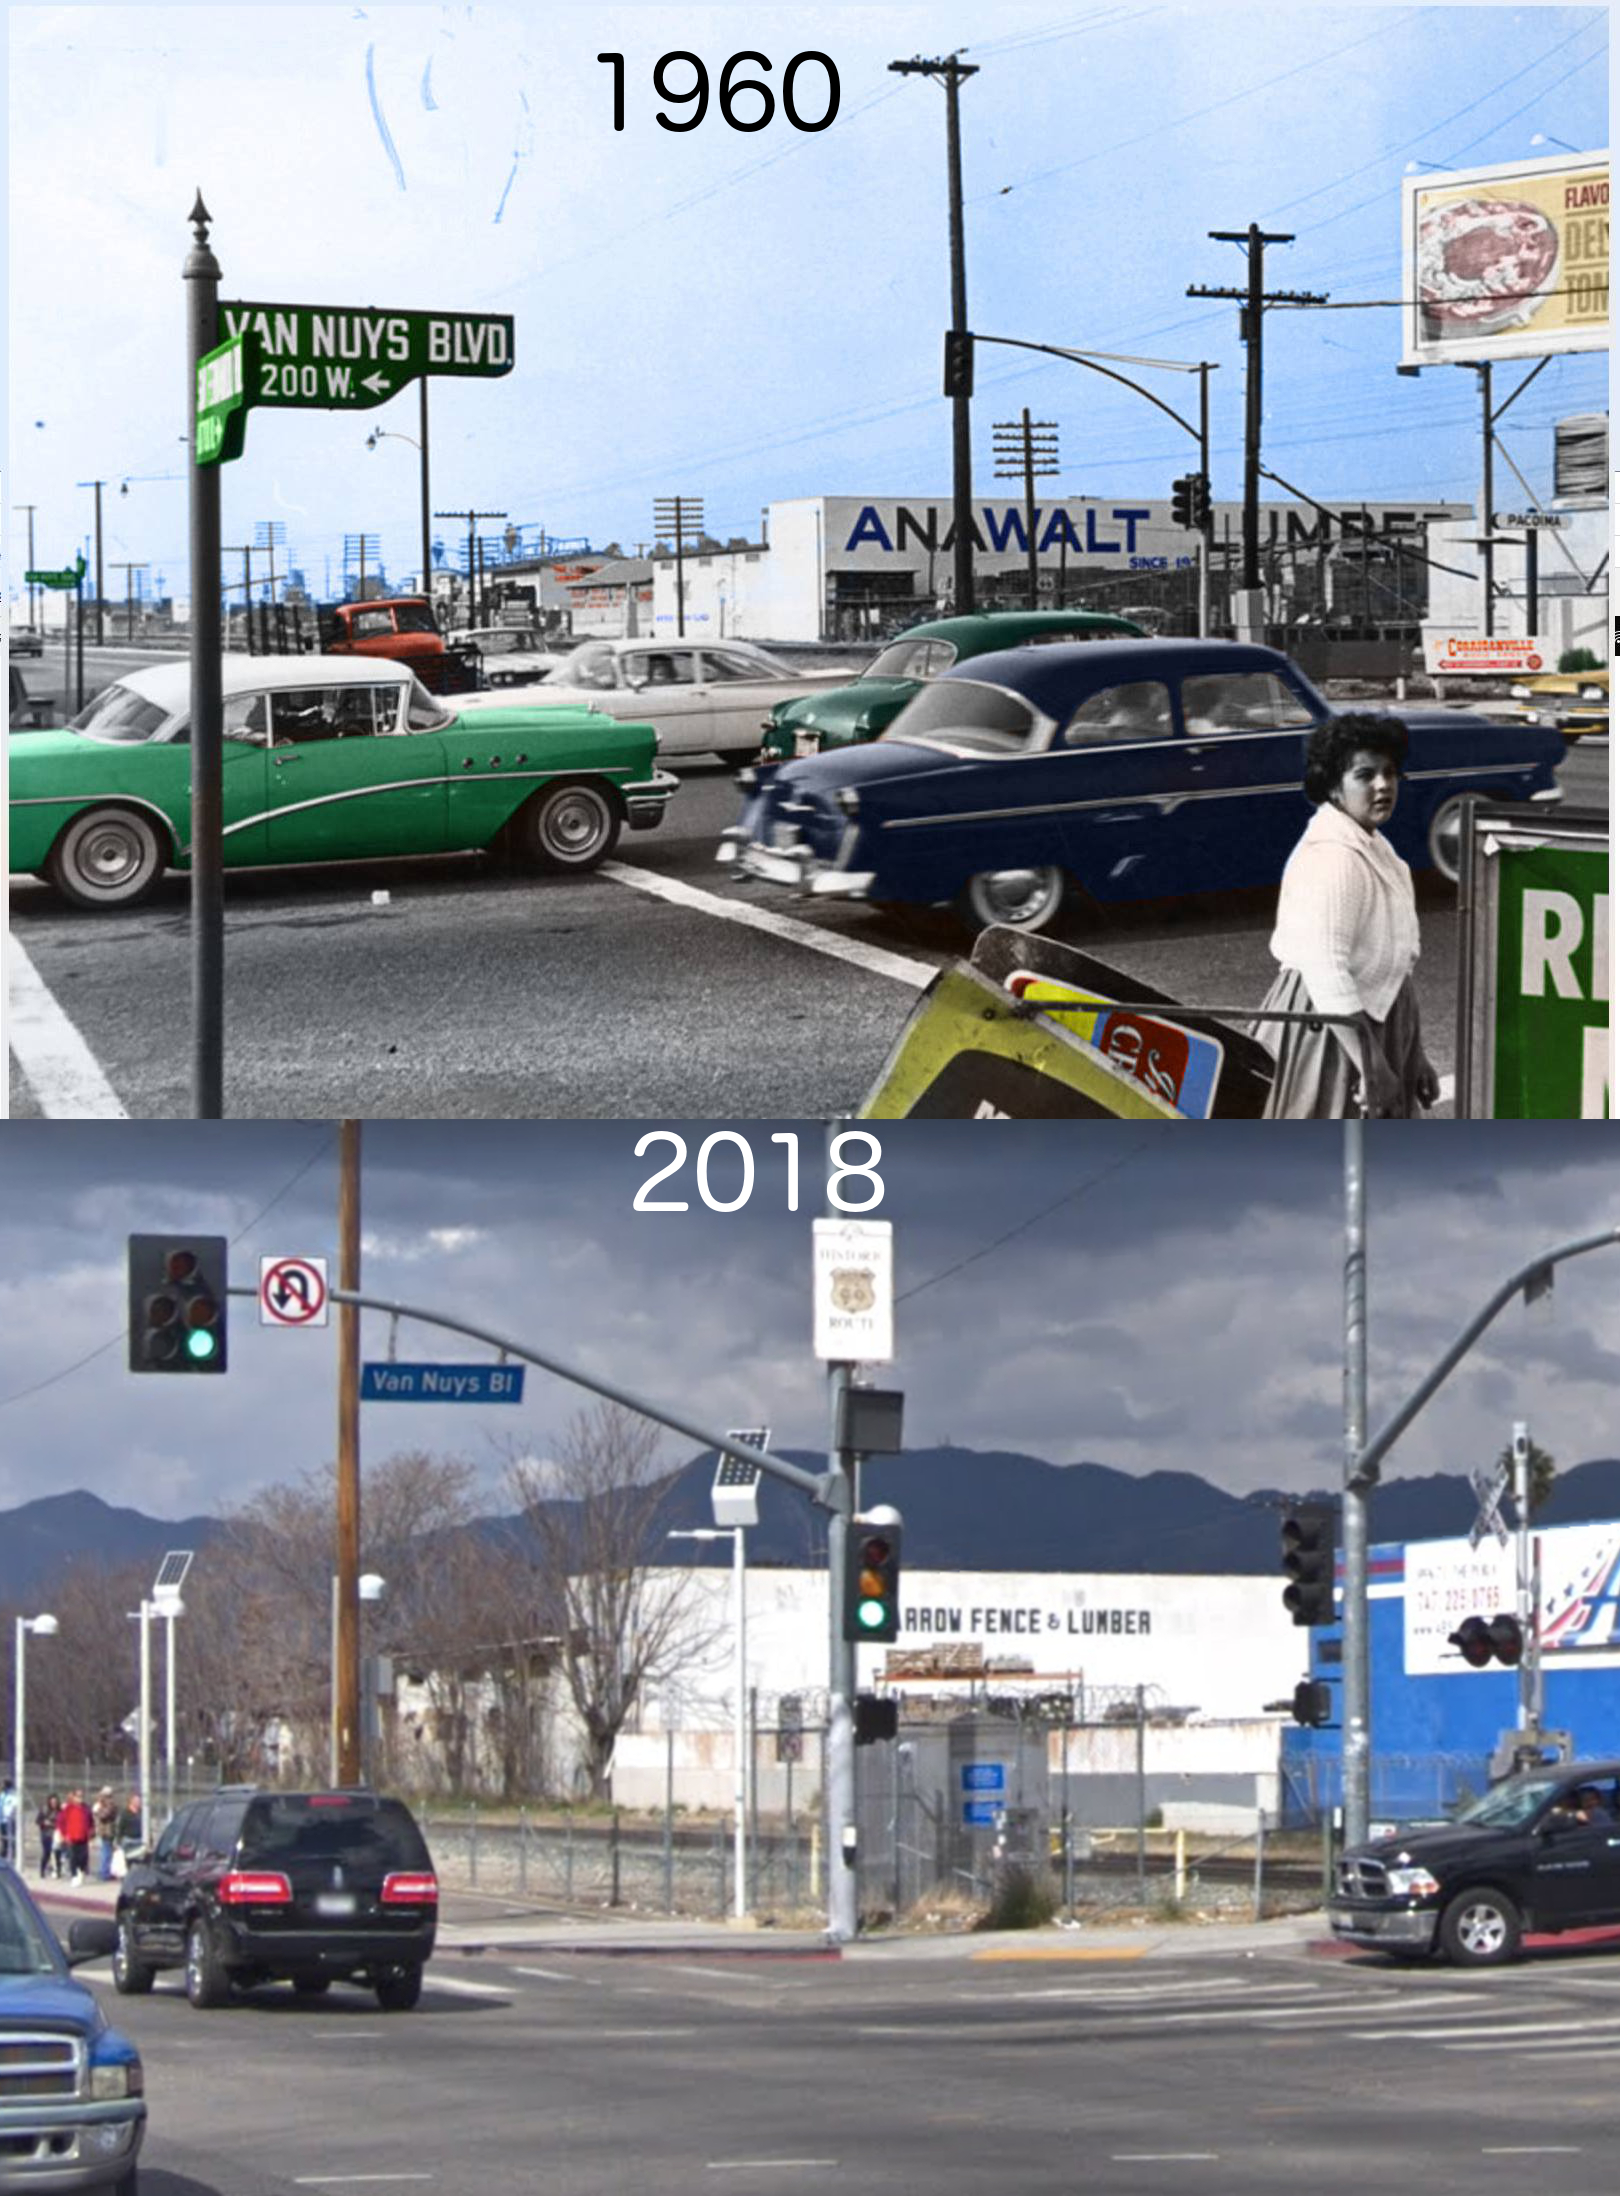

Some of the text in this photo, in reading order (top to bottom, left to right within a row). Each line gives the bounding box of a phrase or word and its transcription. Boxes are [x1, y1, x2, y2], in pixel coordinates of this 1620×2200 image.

[225, 311, 513, 365] VAN NUYS BLVD.
[260, 364, 318, 397] 200
[325, 365, 357, 399] W.
[845, 505, 1150, 553] ANAWALT
[373, 1370, 512, 1397] Van Nuys Bl
[899, 1607, 1151, 1635] RROW FENCE & LUMBER
